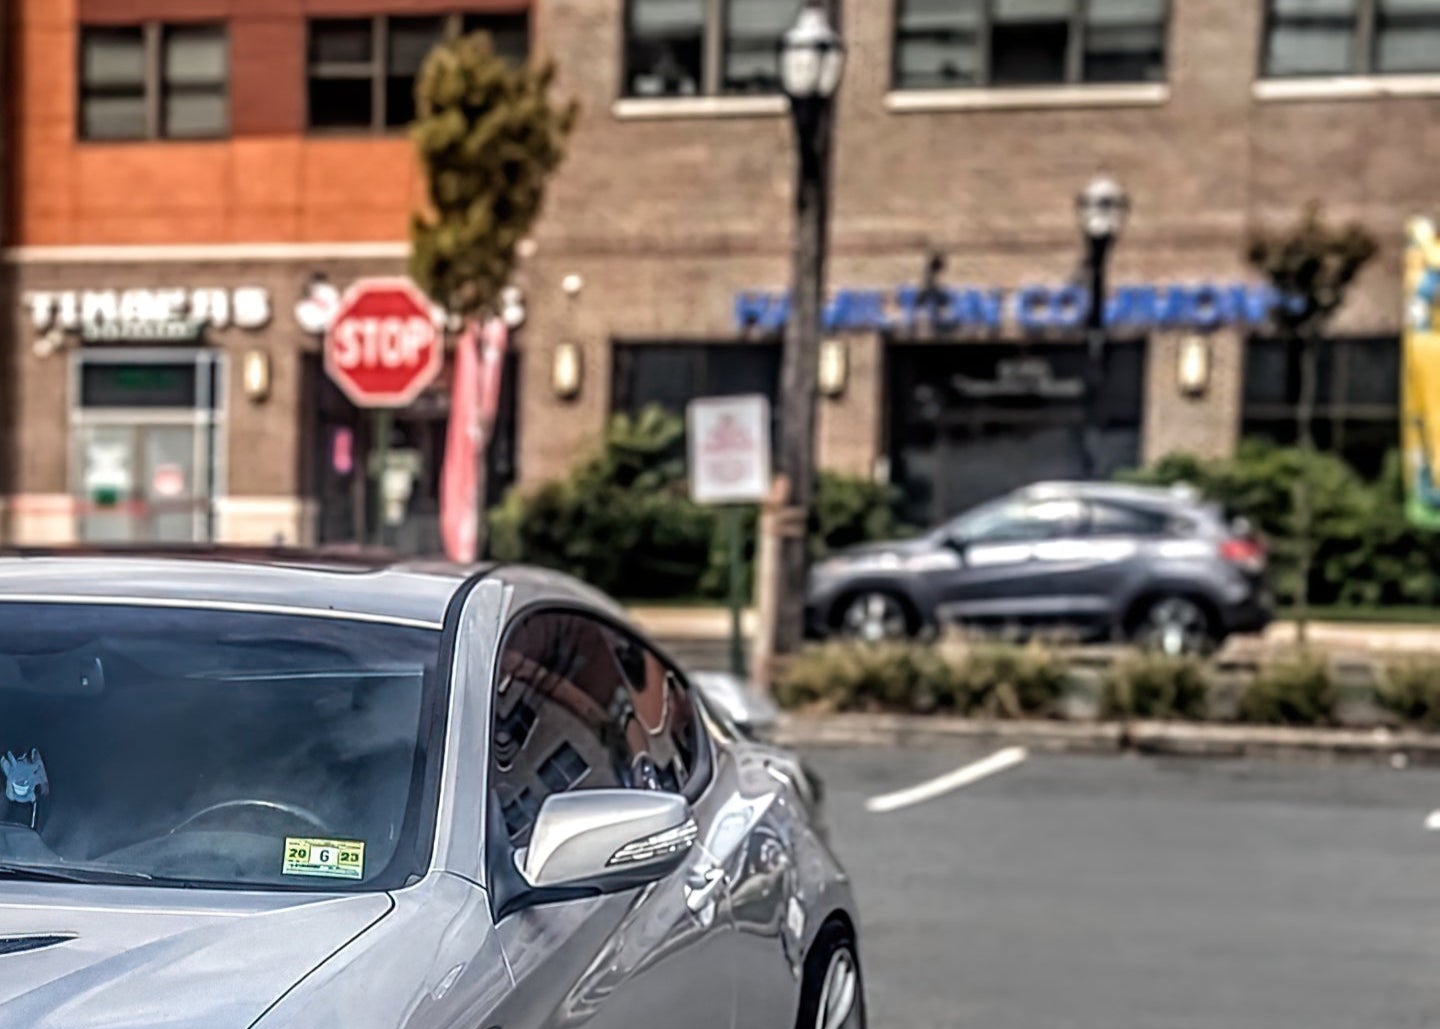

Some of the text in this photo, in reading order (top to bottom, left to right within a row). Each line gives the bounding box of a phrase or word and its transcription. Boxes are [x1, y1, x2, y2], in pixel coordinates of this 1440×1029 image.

[333, 316, 435, 369] STOP
[289, 848, 307, 859] 20
[340, 851, 359, 862] 23
